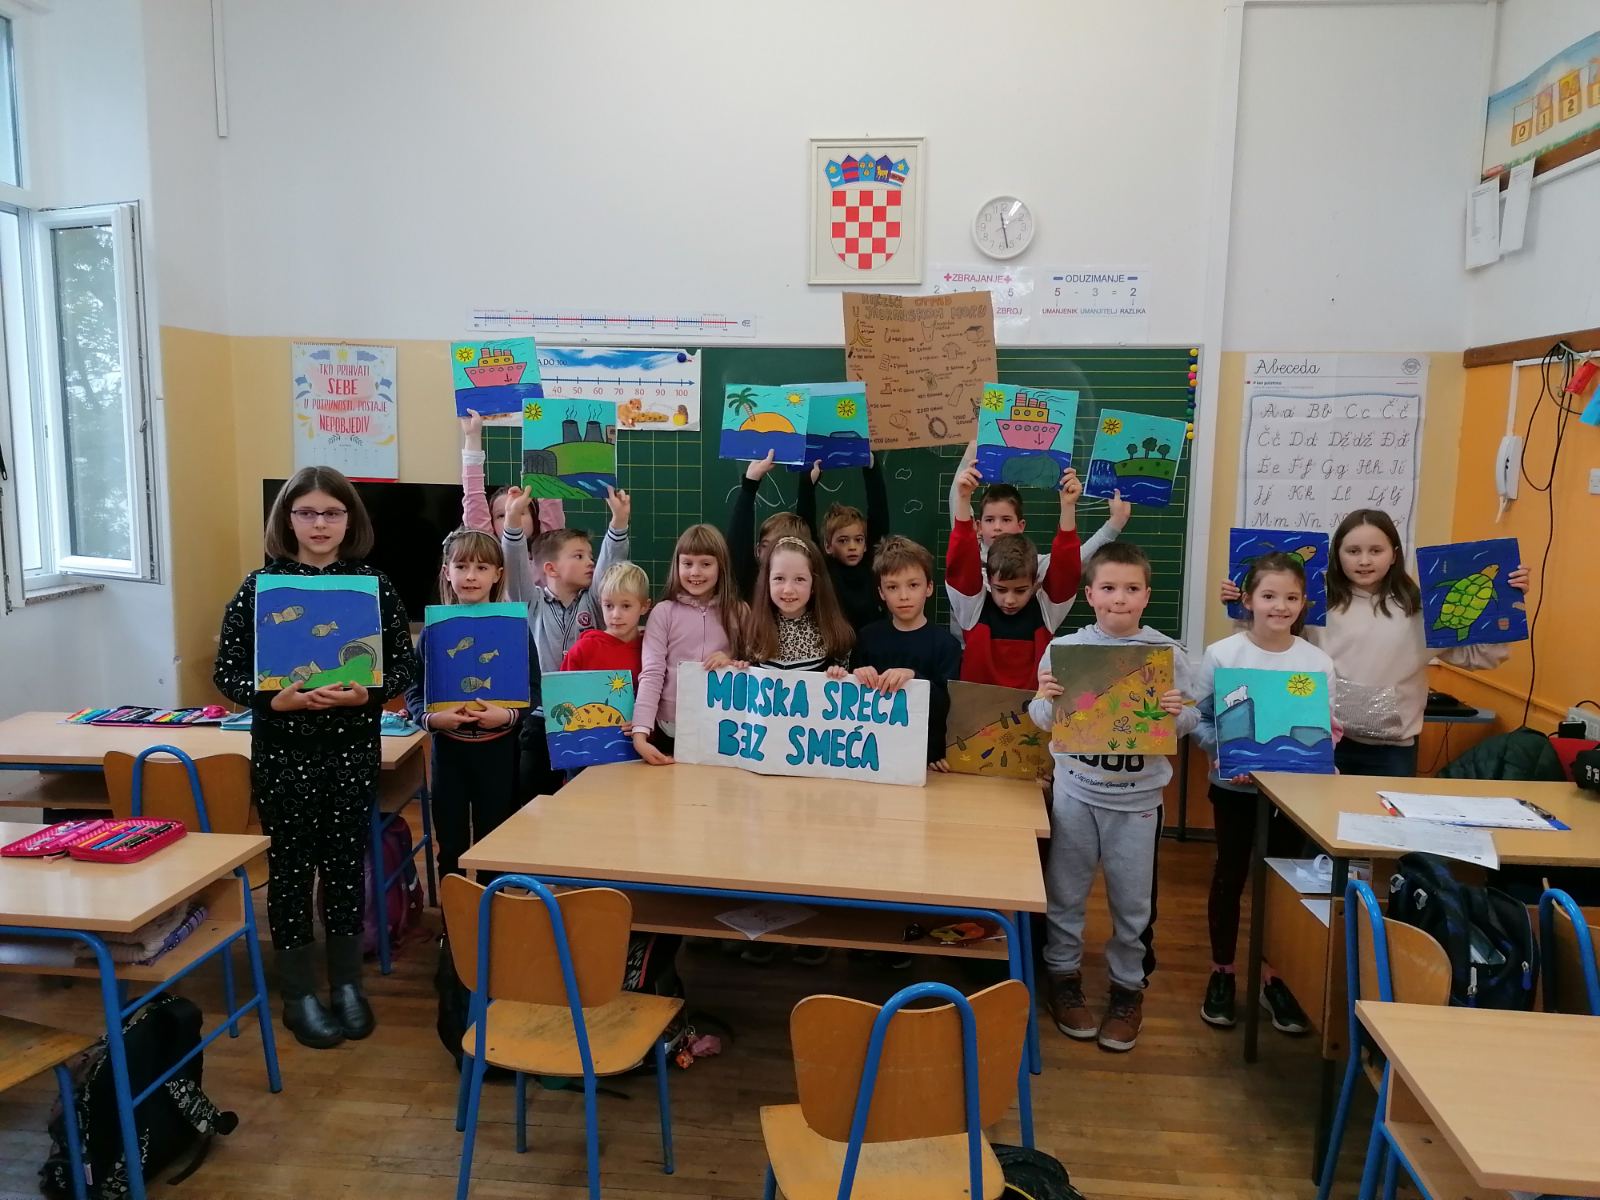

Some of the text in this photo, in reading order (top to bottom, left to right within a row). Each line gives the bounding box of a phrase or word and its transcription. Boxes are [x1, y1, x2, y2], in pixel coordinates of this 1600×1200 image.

[951, 273, 1004, 284] ZBRAJANJE
[1065, 274, 1125, 283] ODUZIMANJE
[1054, 287, 1061, 297] 5
[1130, 288, 1137, 297] 2
[996, 306, 1023, 315] ZBROJ
[337, 365, 369, 377] PRIHVATI
[1256, 358, 1320, 374] Abeceda
[328, 378, 359, 395] SEBE
[593, 387, 603, 395] 60
[676, 389, 688, 397] 100
[319, 414, 370, 433] NEPOBJEDIV
[707, 670, 809, 718] MORSKA
[718, 719, 879, 771] BEZ SMEĆA
